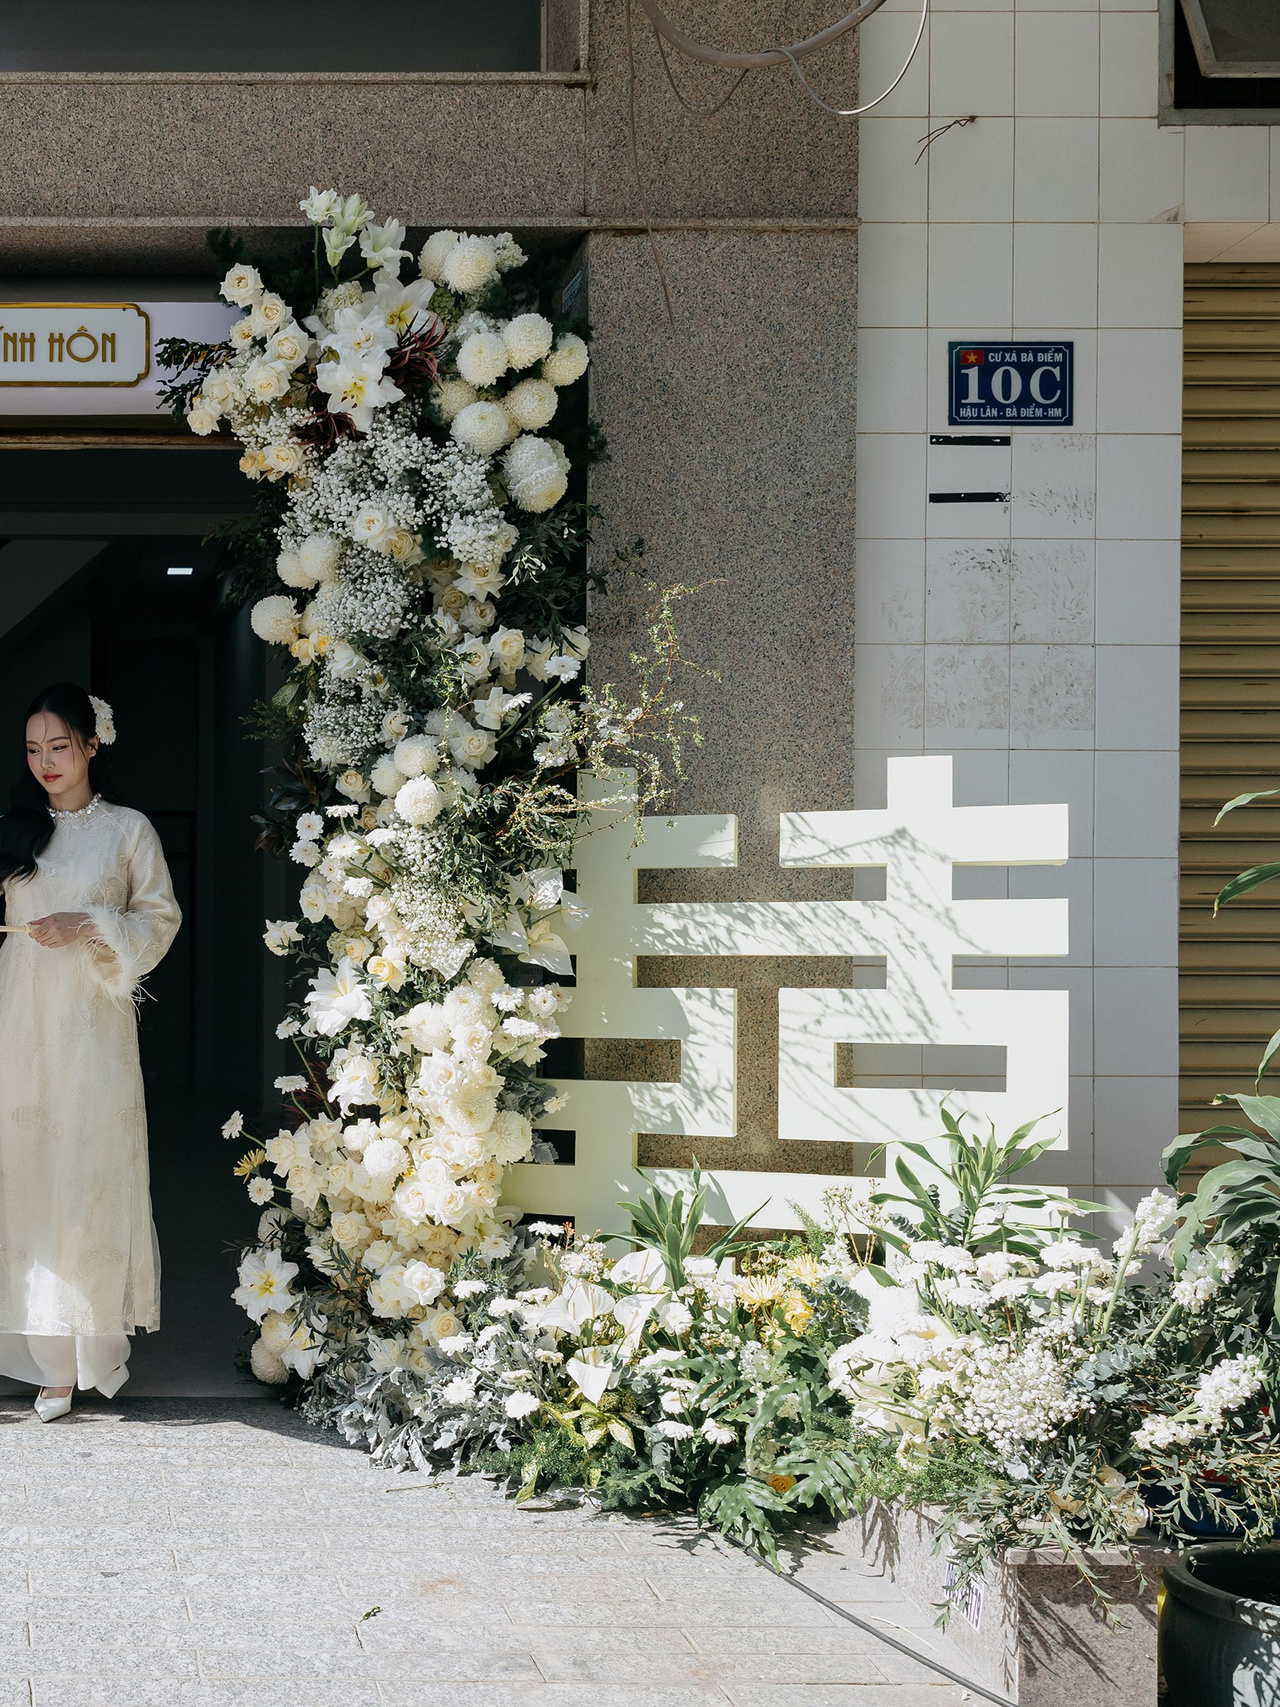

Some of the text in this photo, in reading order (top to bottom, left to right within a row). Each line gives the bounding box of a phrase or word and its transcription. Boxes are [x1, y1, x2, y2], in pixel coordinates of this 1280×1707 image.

[48, 326, 116, 363] HÔN
[988, 348, 1062, 363] CƯ XÁ BÀ ĐIỂM
[960, 405, 978, 419] HẬU
[980, 405, 998, 418] LÂN
[1006, 405, 1018, 418] BÀ
